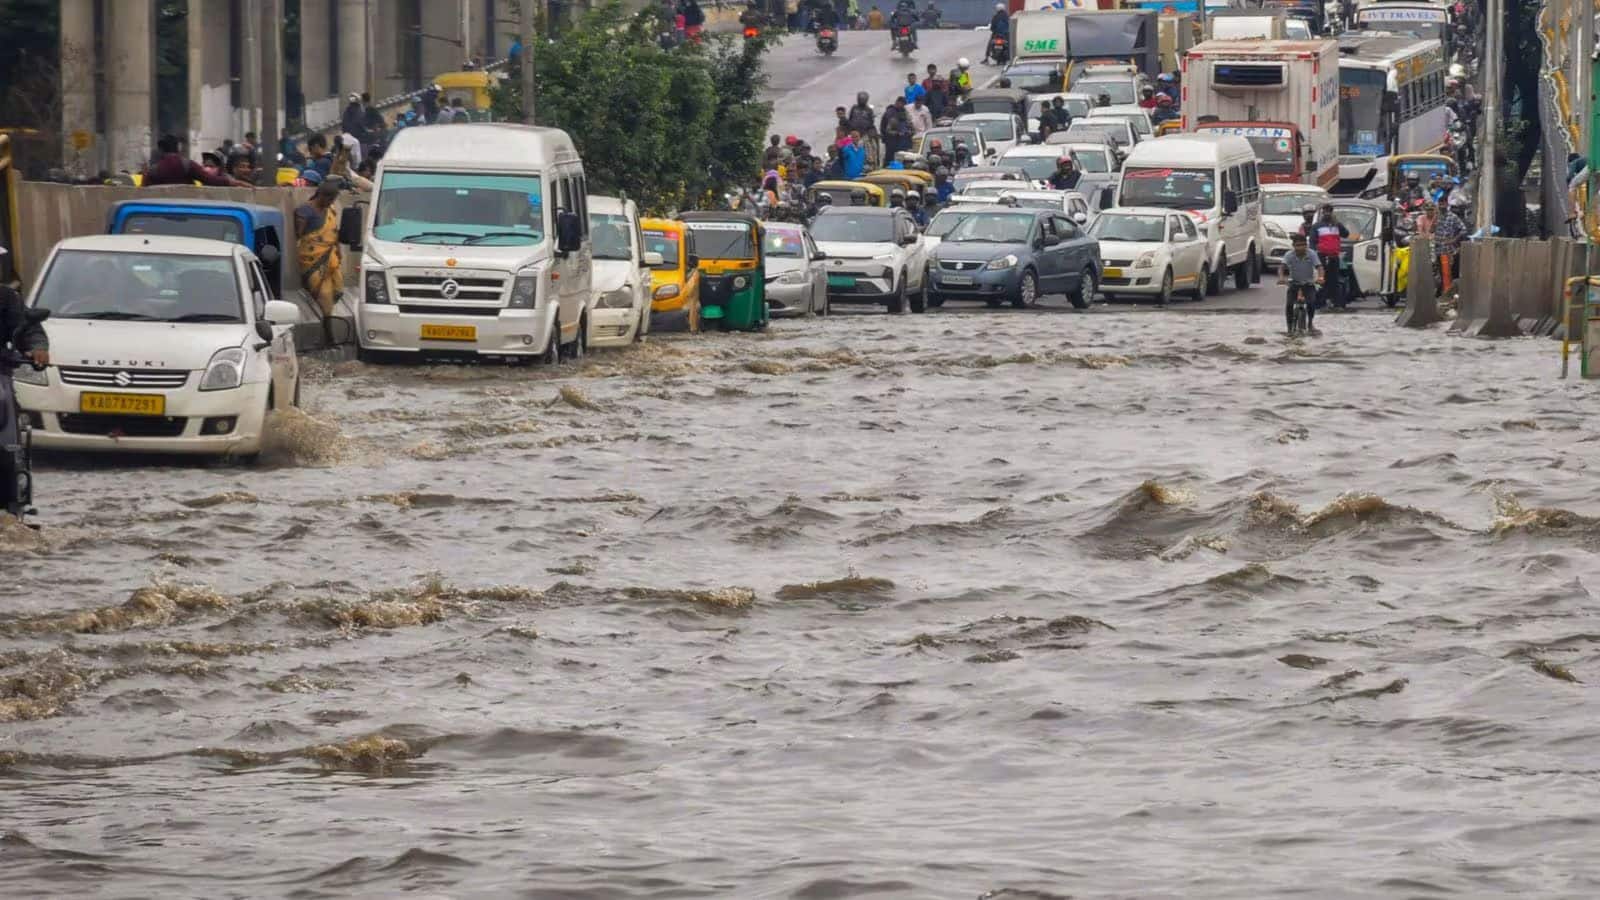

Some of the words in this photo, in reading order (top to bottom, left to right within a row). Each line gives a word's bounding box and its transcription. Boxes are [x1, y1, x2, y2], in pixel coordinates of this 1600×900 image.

[1390, 11, 1437, 19] TRAVELS
[1024, 39, 1057, 50] SME
[1210, 127, 1284, 136] DECCAN
[81, 359, 165, 367] SUZUKI
